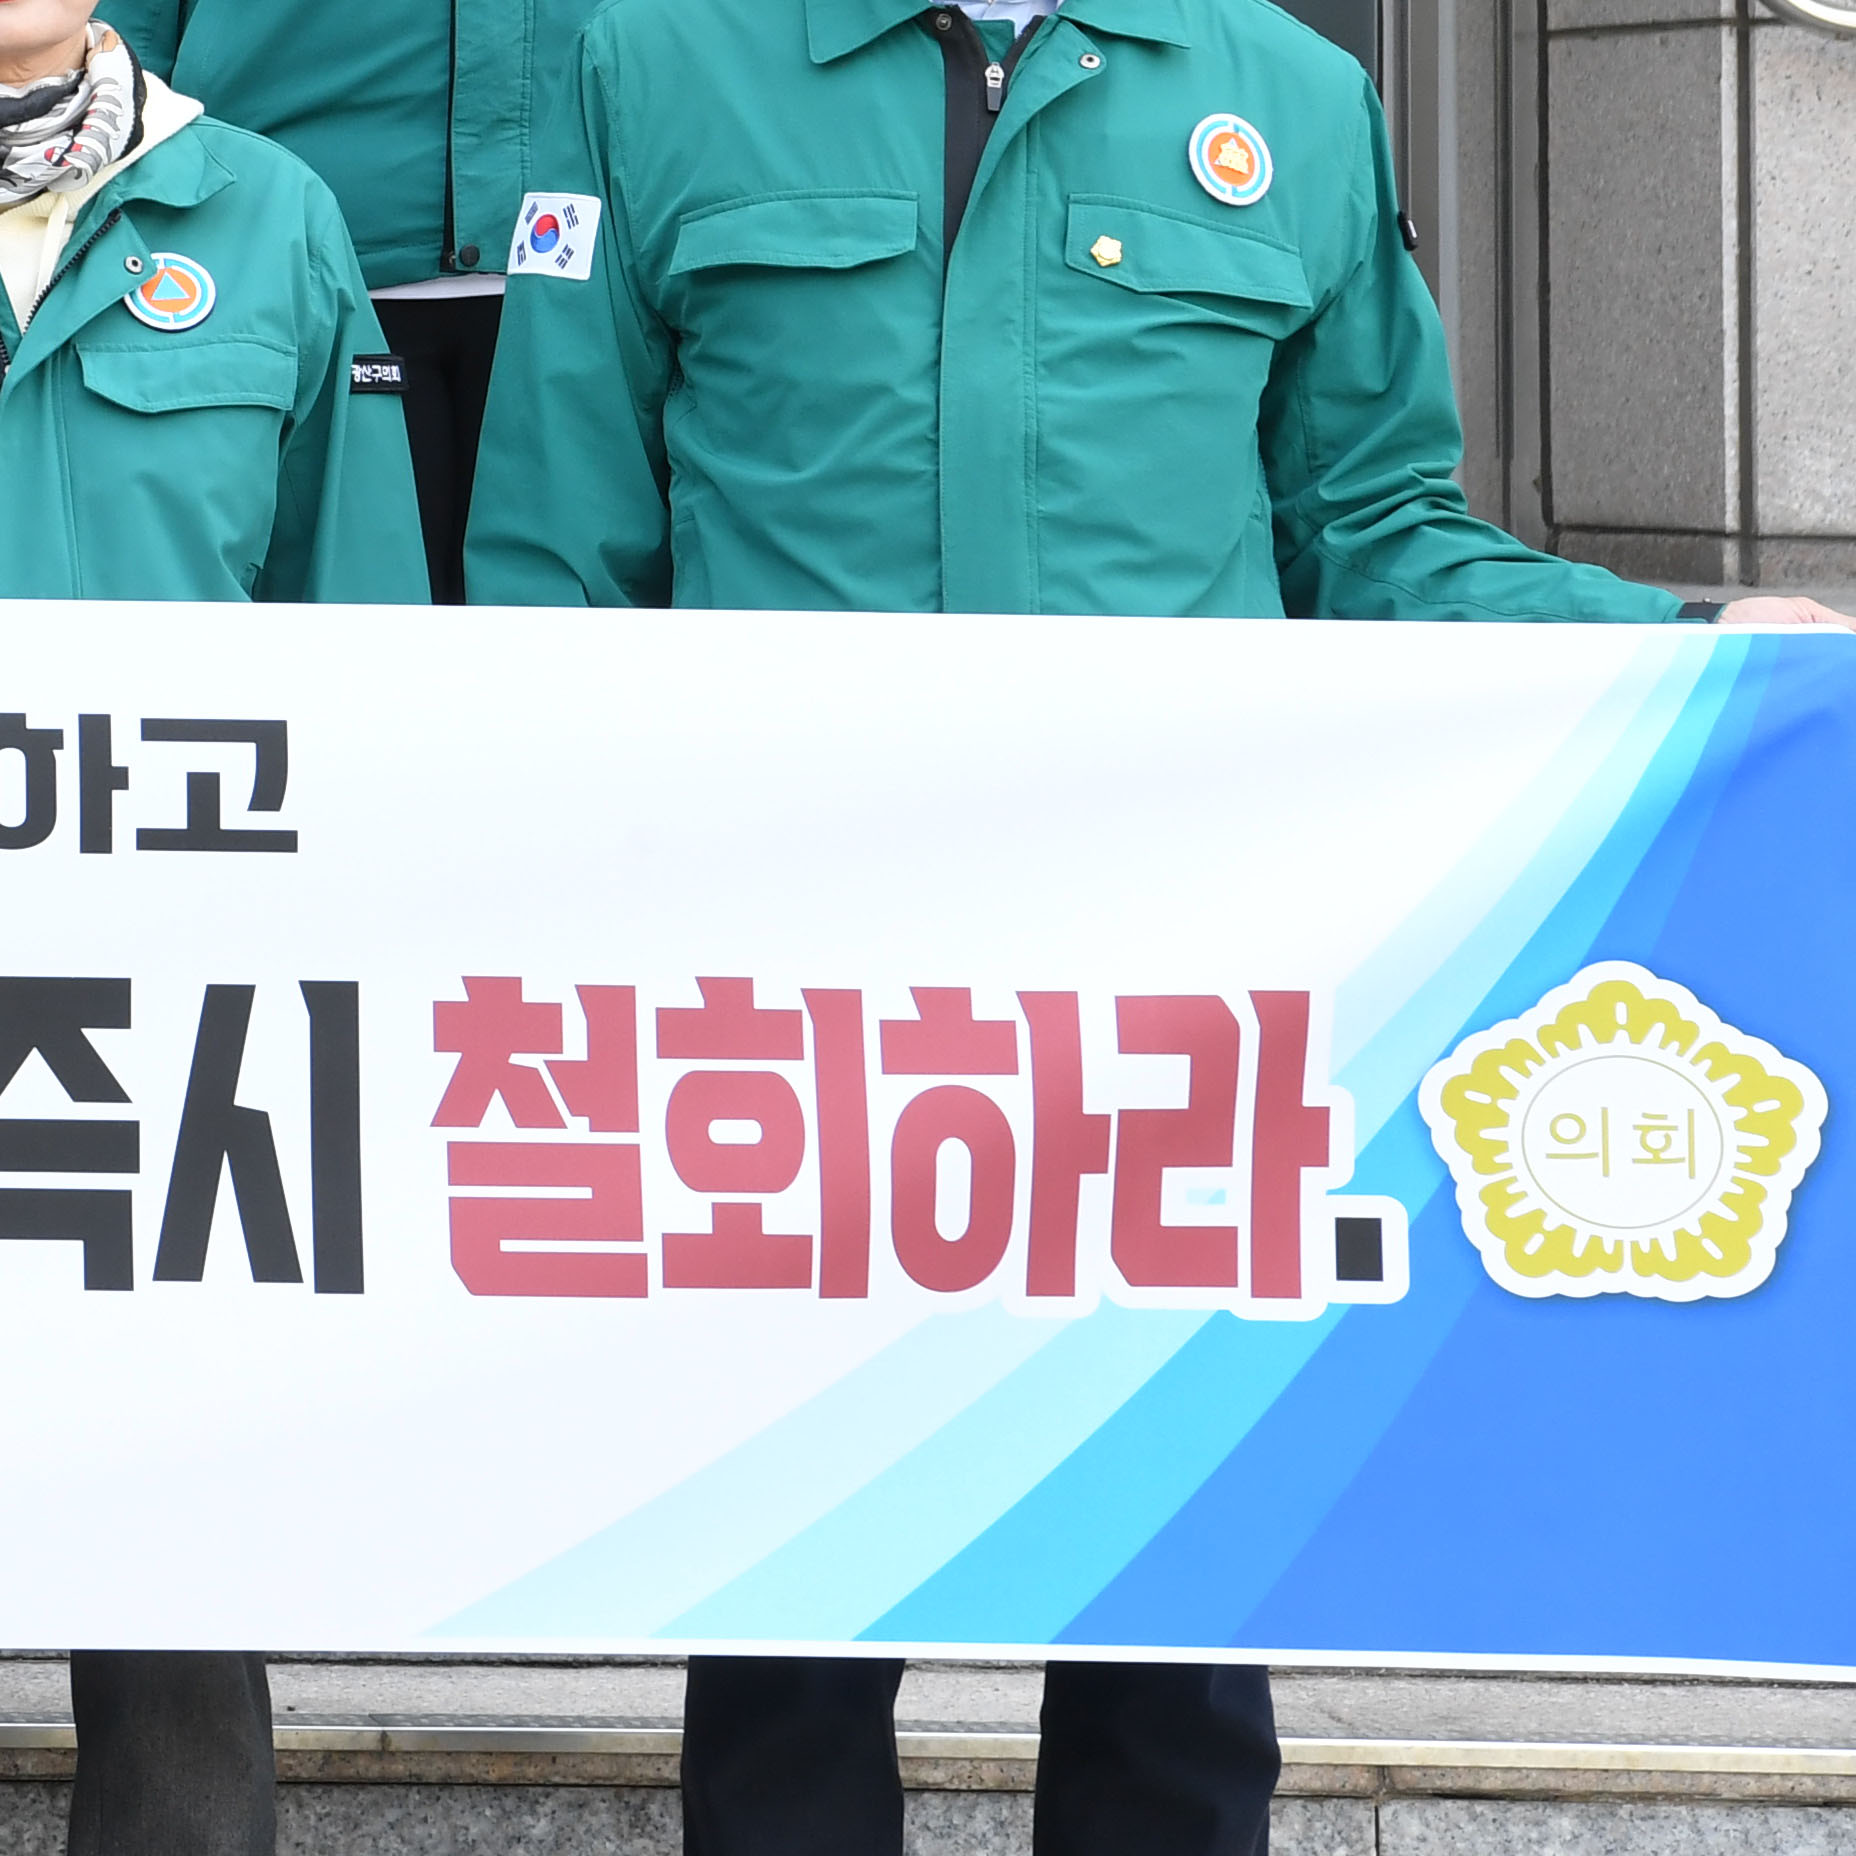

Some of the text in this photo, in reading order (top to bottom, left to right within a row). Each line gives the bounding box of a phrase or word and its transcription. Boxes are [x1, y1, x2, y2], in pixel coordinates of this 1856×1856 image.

[351, 364, 402, 383] 광산구의회
[433, 977, 1383, 1299] 철회하라.
[1545, 1107, 1695, 1179] 의회
